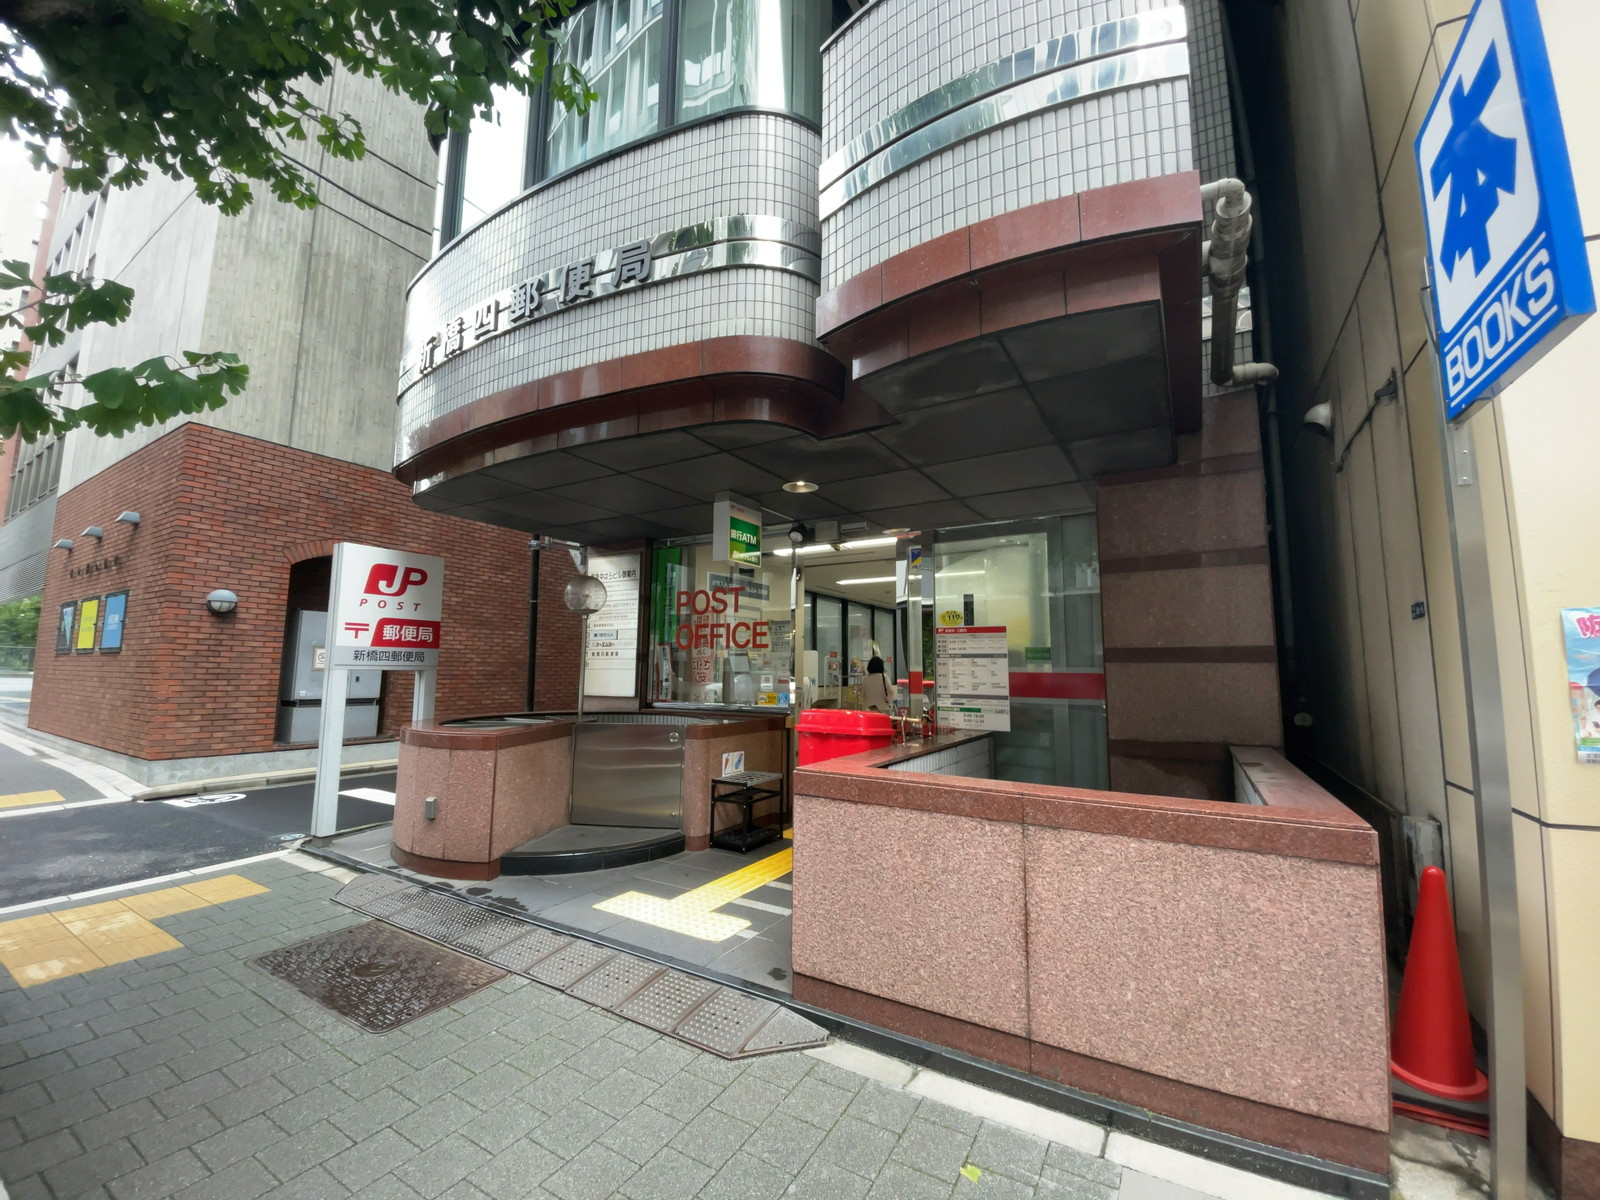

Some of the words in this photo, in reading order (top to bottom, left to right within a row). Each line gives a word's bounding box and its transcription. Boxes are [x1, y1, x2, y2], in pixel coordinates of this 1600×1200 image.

[1445, 247, 1556, 399] BOOKS
[363, 563, 428, 597] JP
[359, 598, 421, 611] POST
[676, 586, 746, 616] POST
[382, 625, 433, 643] 郵便局
[675, 621, 770, 651] OFFICE
[352, 649, 425, 663] 新橋四郵便局
